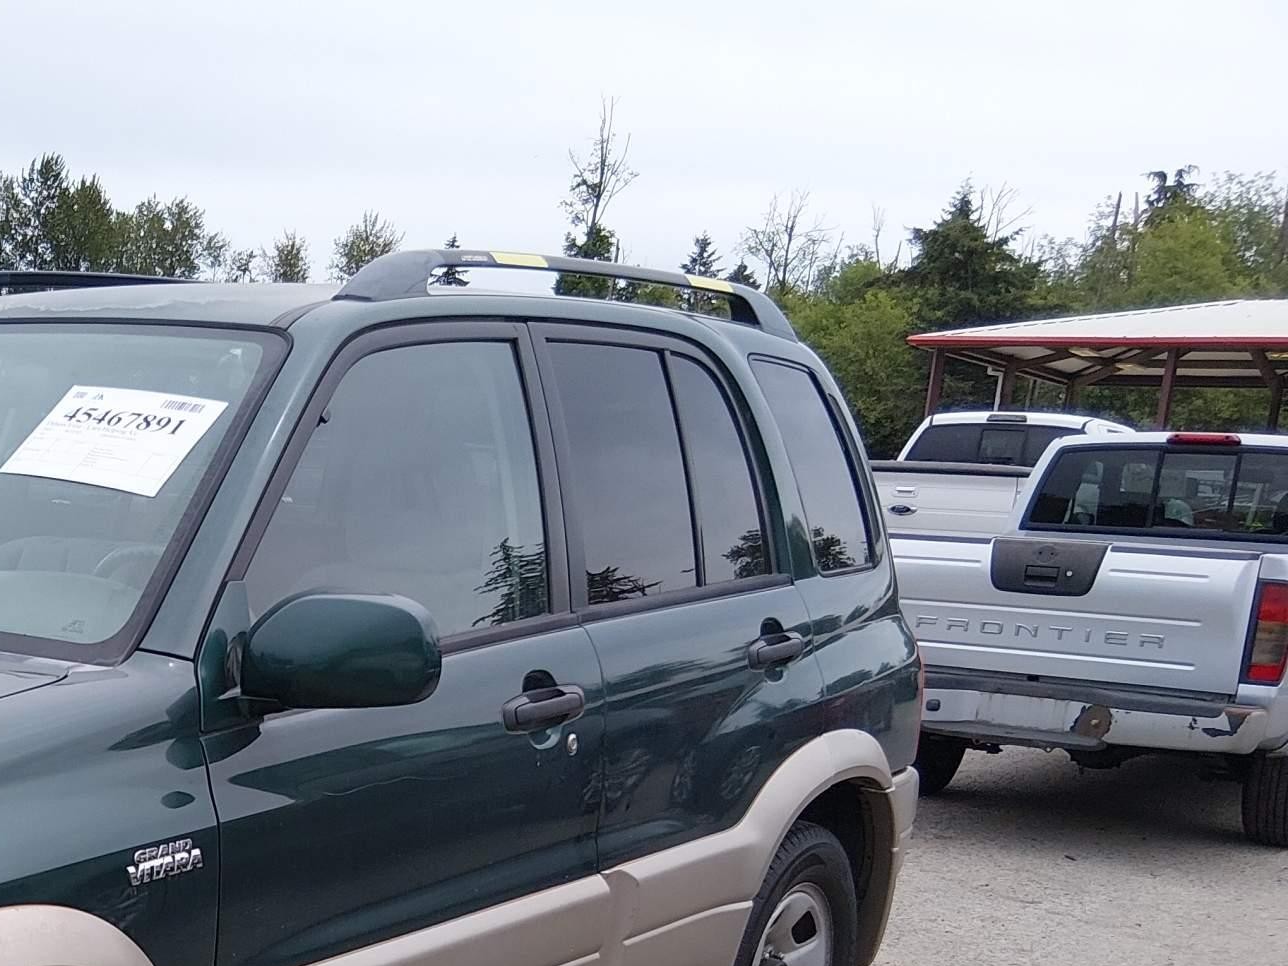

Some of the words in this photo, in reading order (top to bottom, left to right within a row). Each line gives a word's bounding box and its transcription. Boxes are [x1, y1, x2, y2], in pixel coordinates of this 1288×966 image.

[63, 406, 187, 436] 45467891
[915, 614, 1166, 649] FRONTIER
[134, 838, 193, 863] GRAND
[126, 848, 203, 886] VITARA
